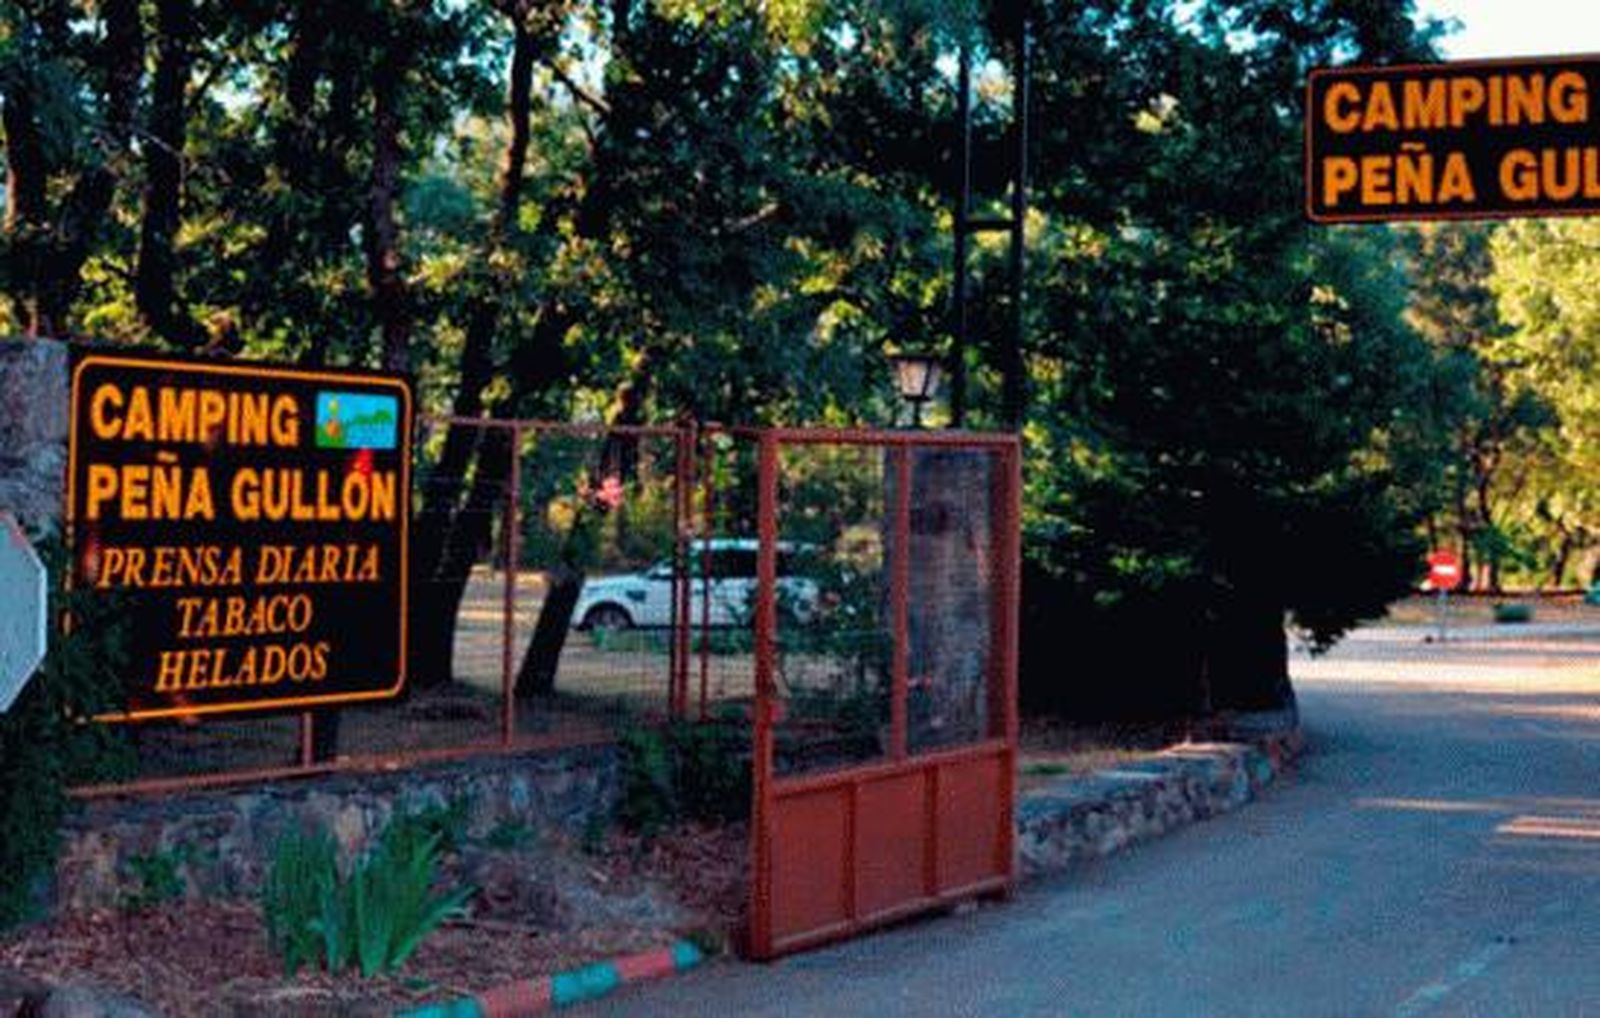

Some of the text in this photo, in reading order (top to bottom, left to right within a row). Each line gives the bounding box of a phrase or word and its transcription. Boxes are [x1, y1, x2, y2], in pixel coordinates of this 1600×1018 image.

[1323, 71, 1589, 133] CAMPING
[1322, 141, 1600, 206] PEÑA GUL
[90, 383, 299, 447] CAMPING
[86, 451, 214, 520] PEÑA
[97, 544, 380, 588] PRENSA DIARIA
[177, 594, 312, 637] TABACO
[155, 642, 330, 692] HELADOS
